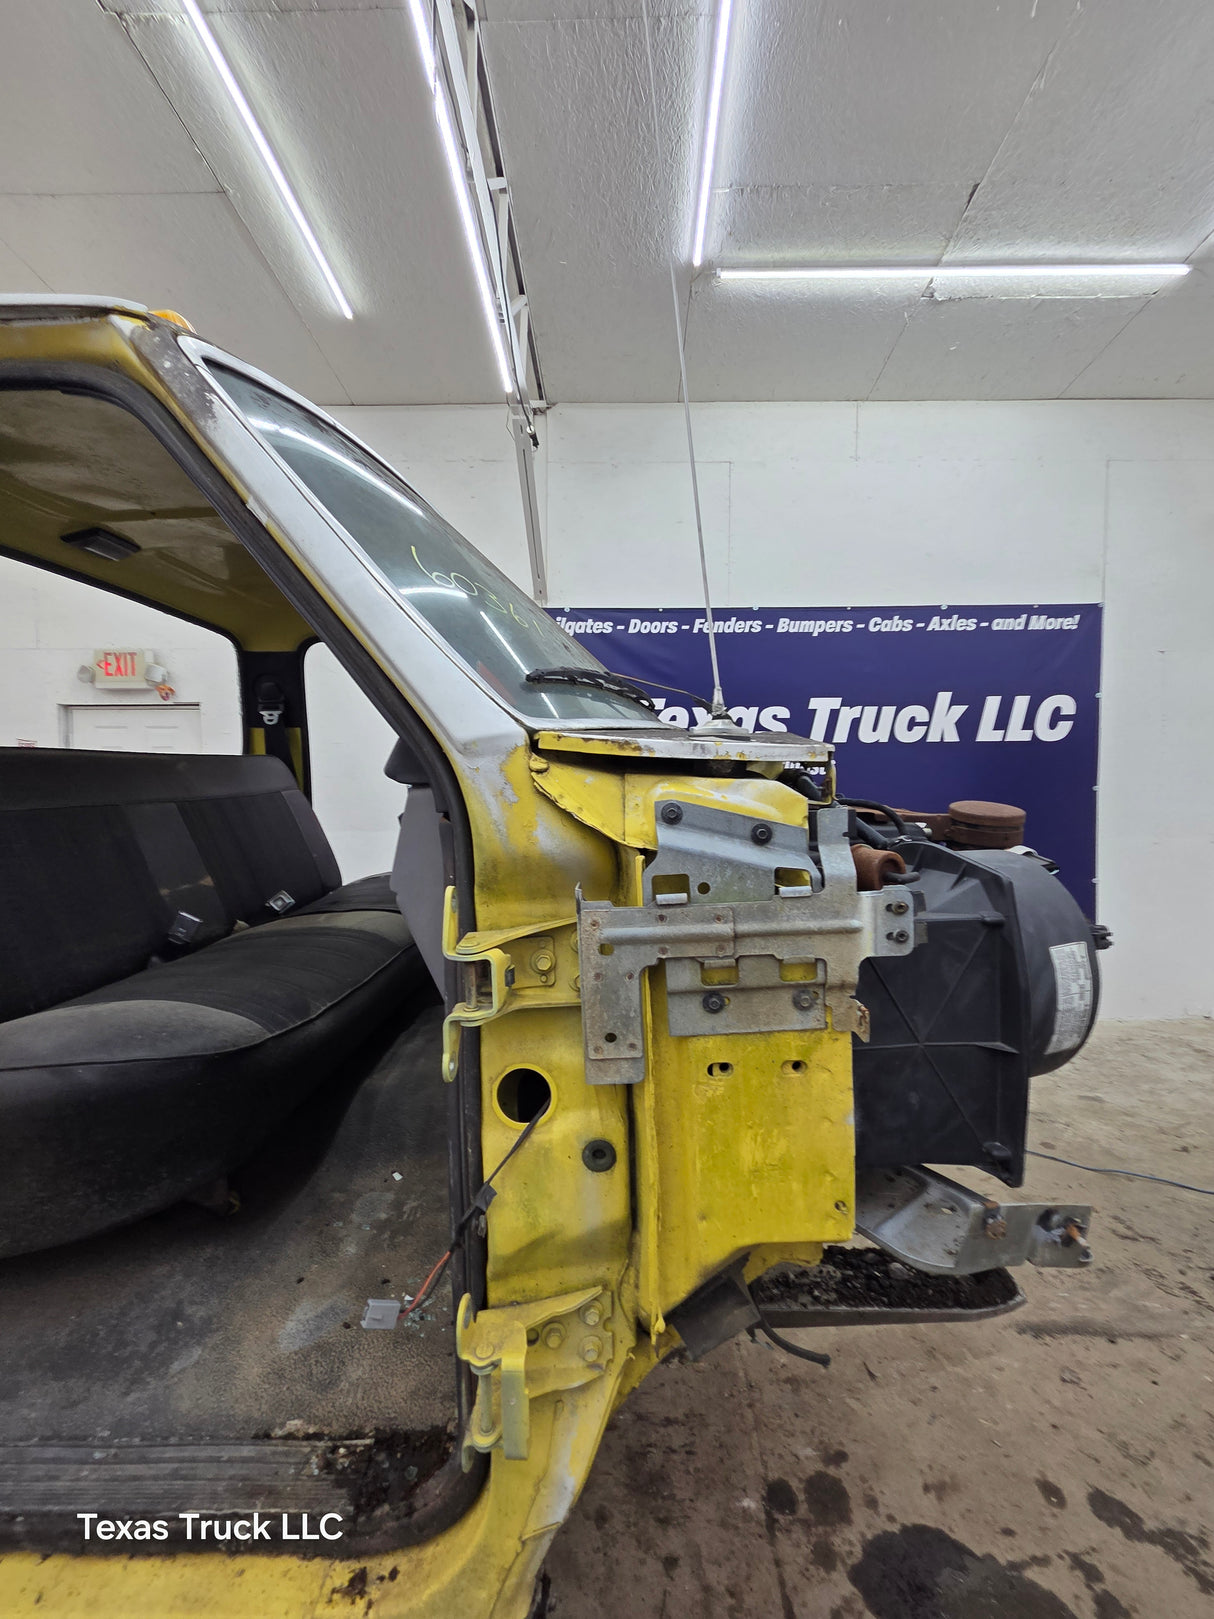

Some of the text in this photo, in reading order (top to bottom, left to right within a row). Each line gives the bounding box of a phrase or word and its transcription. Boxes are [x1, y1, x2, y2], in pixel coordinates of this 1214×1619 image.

[627, 618, 679, 634] Doors
[692, 616, 763, 634] Fenders
[776, 617, 854, 637] Bumpers
[868, 616, 914, 633] Cabs
[926, 614, 978, 632] Axles
[991, 613, 1028, 631] and
[1027, 614, 1081, 631] More!
[103, 652, 138, 677] EXIT
[807, 691, 969, 744] Truck
[975, 694, 1077, 742] LLC
